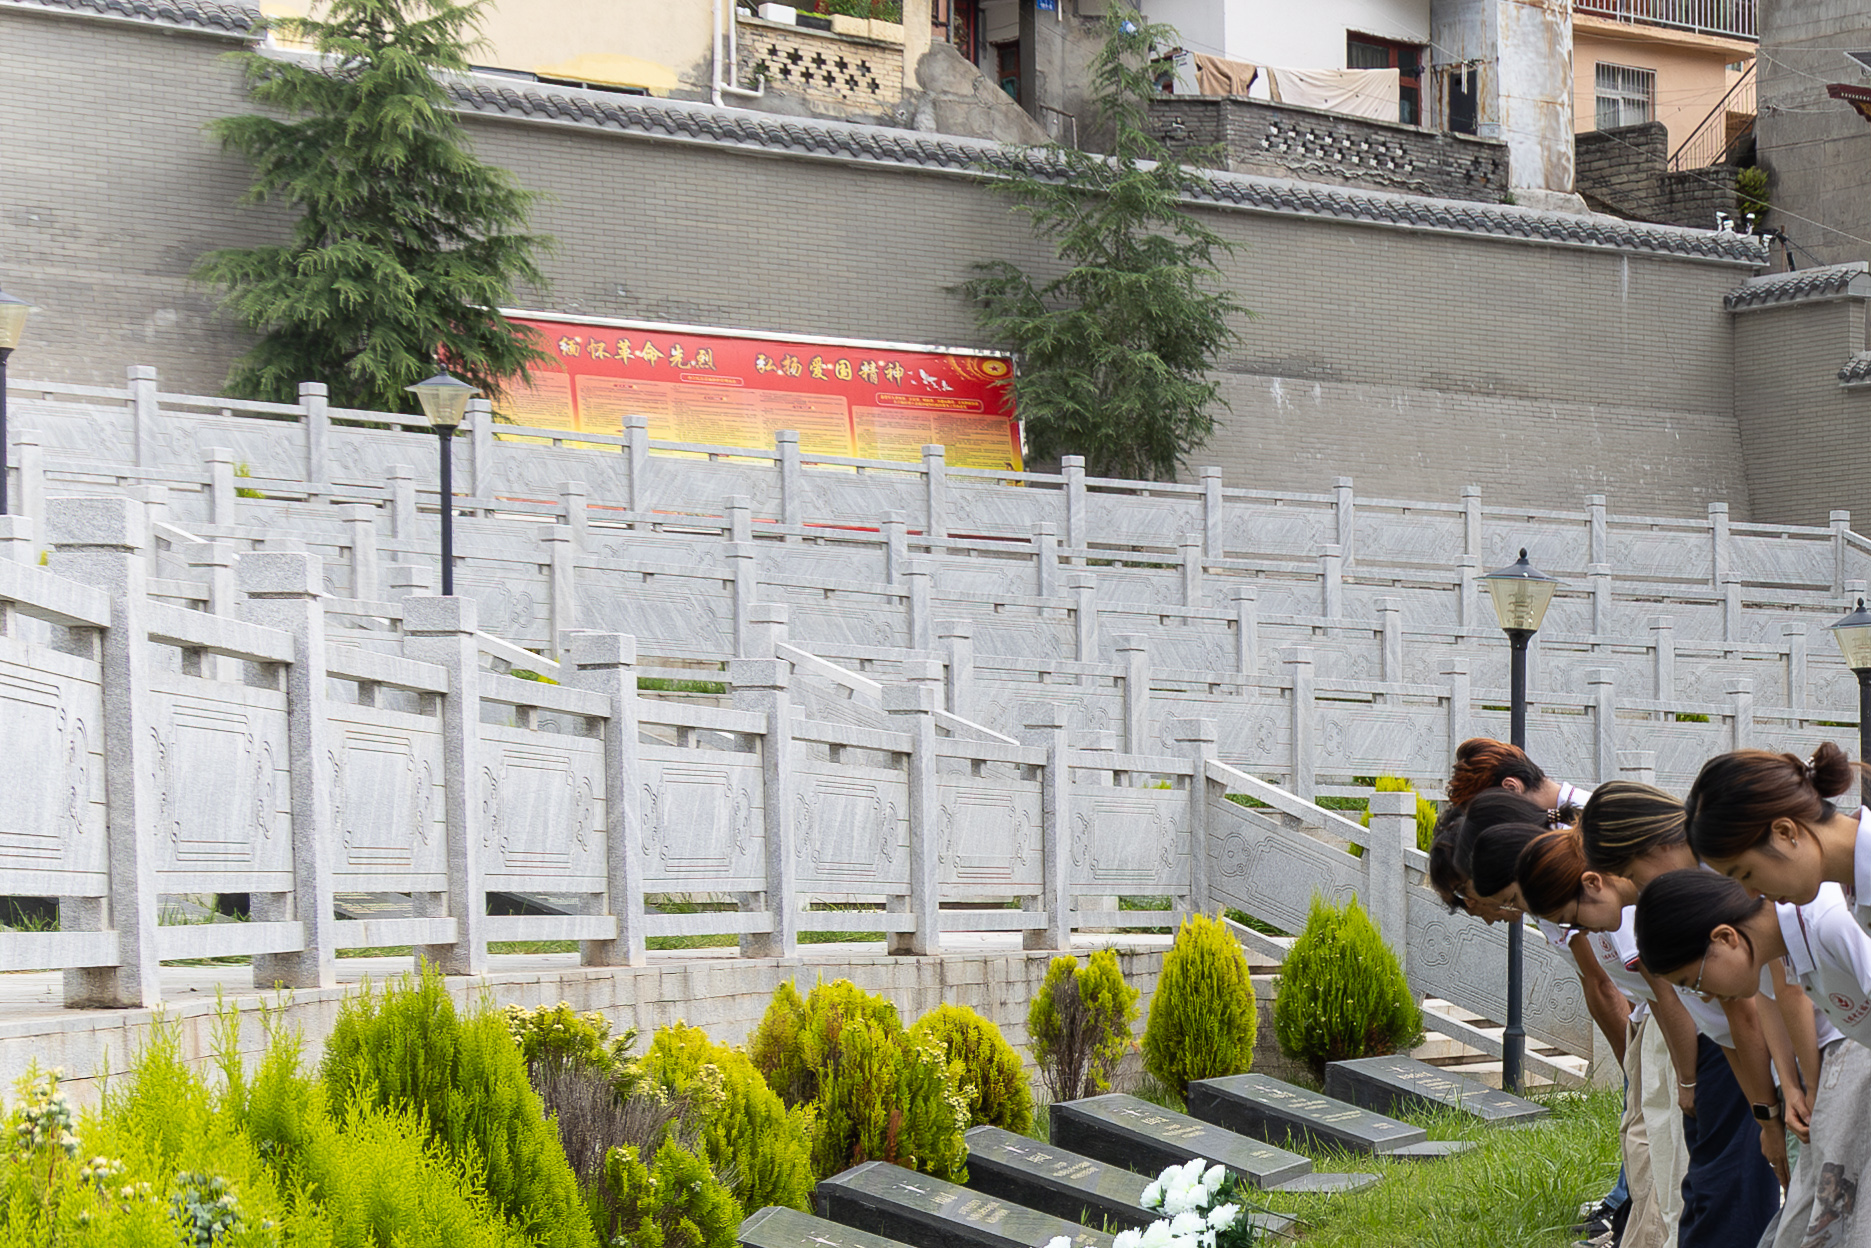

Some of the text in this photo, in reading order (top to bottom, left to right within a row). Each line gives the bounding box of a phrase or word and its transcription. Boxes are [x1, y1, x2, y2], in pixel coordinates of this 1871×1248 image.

[559, 336, 905, 387] 缅怀革命先烈 弘扬爱国精神
